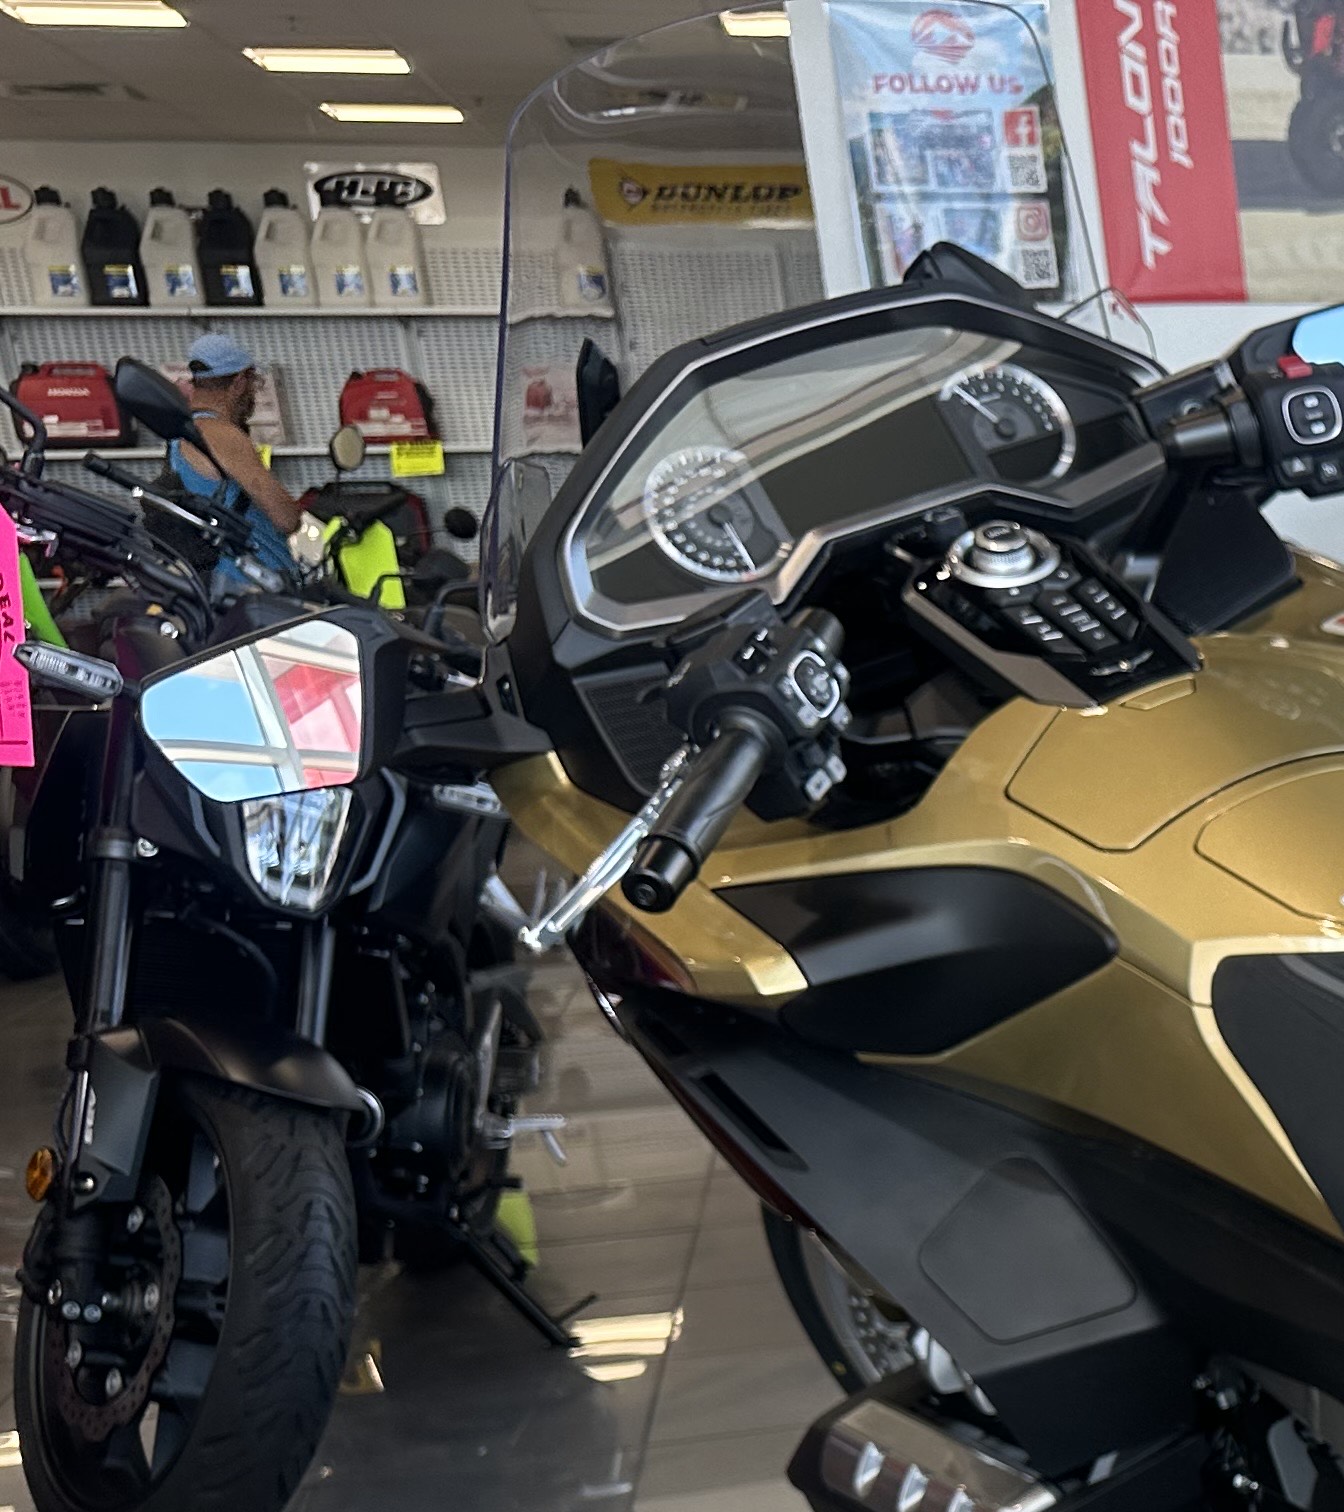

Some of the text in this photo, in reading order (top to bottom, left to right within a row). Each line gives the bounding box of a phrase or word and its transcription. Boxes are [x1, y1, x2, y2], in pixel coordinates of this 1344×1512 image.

[872, 73, 1024, 95] FOLLOW US
[1113, 0, 1174, 270] TALON
[655, 183, 802, 203] DUNLOP
[0, 573, 16, 644] EAL
